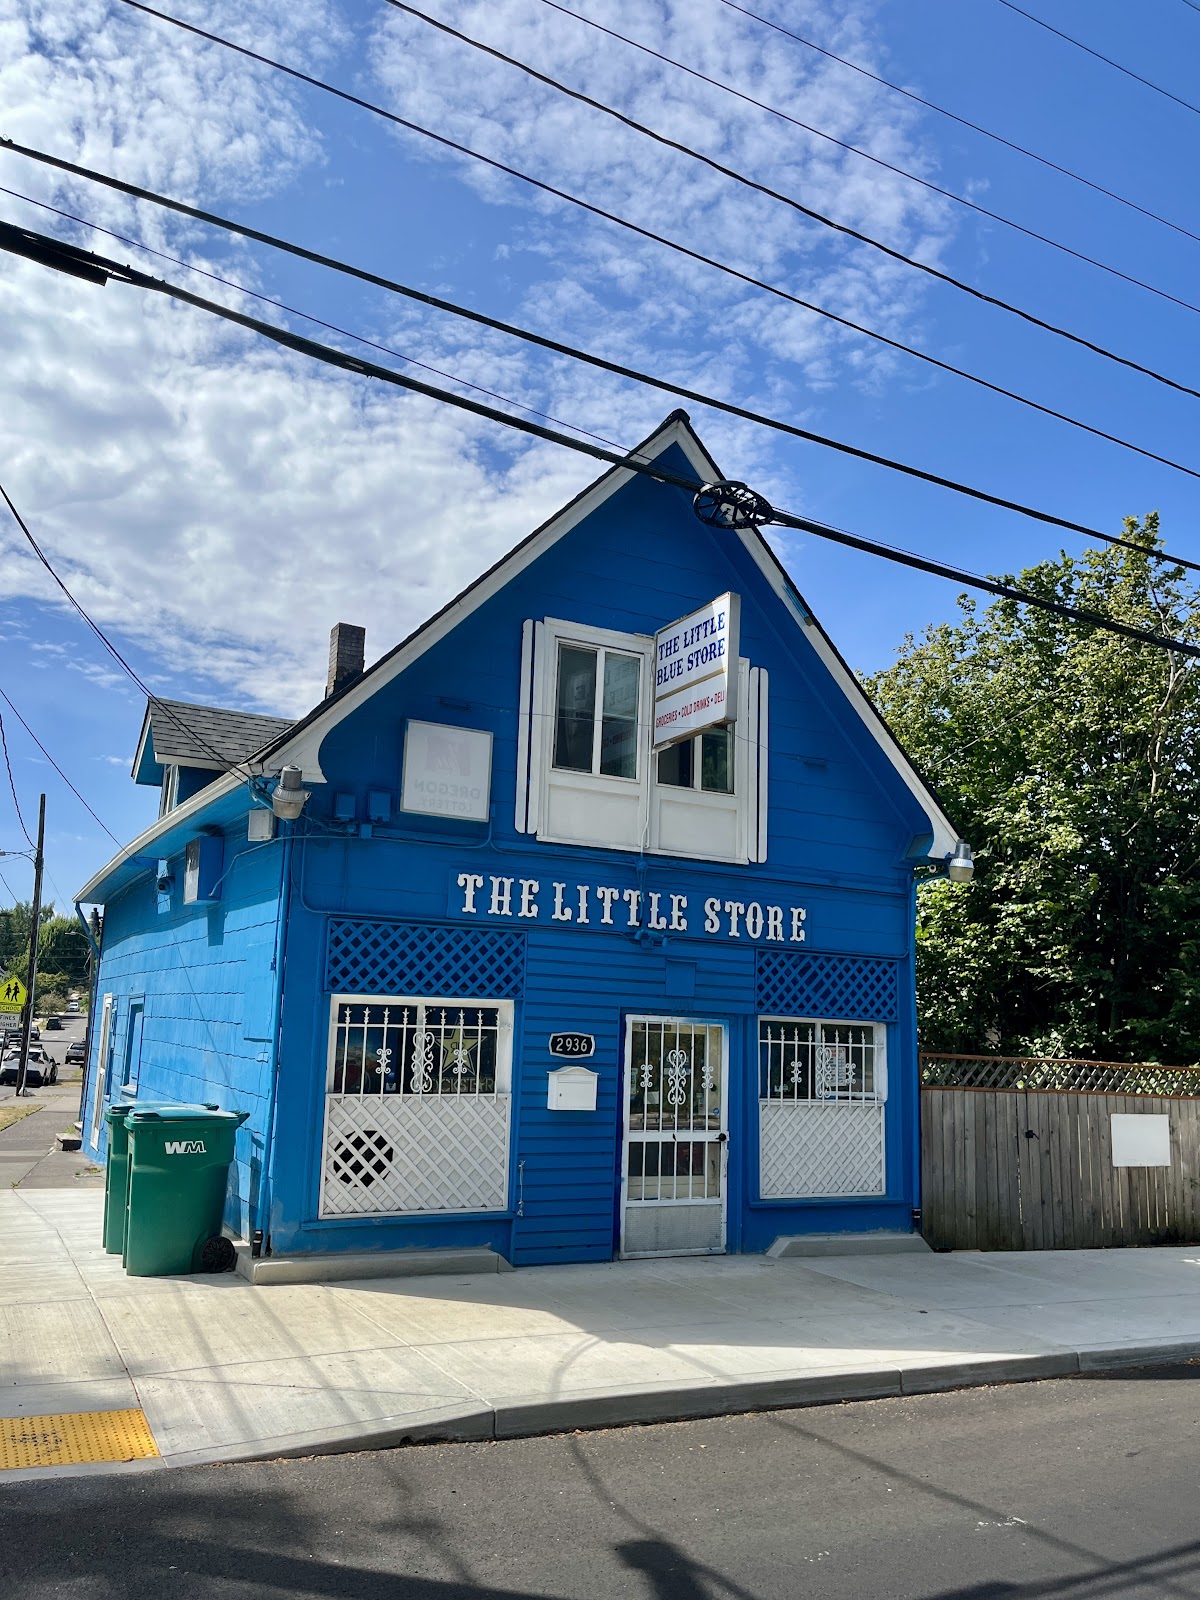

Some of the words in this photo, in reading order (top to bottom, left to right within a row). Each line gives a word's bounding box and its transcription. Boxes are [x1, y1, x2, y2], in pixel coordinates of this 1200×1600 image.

[658, 635, 680, 661] THE
[683, 611, 725, 648] LITTLE
[656, 660, 684, 686] BLUE
[687, 638, 726, 672] STORE
[656, 709, 678, 729] GROCERIES
[681, 703, 693, 717] COLD
[693, 695, 710, 713] DRINKS
[714, 690, 726, 704] DELI
[457, 873, 540, 918] THE
[551, 882, 688, 931] LITTLE
[704, 897, 807, 942] STORE
[556, 1037, 588, 1052] 2936
[164, 1140, 207, 1155] WM
